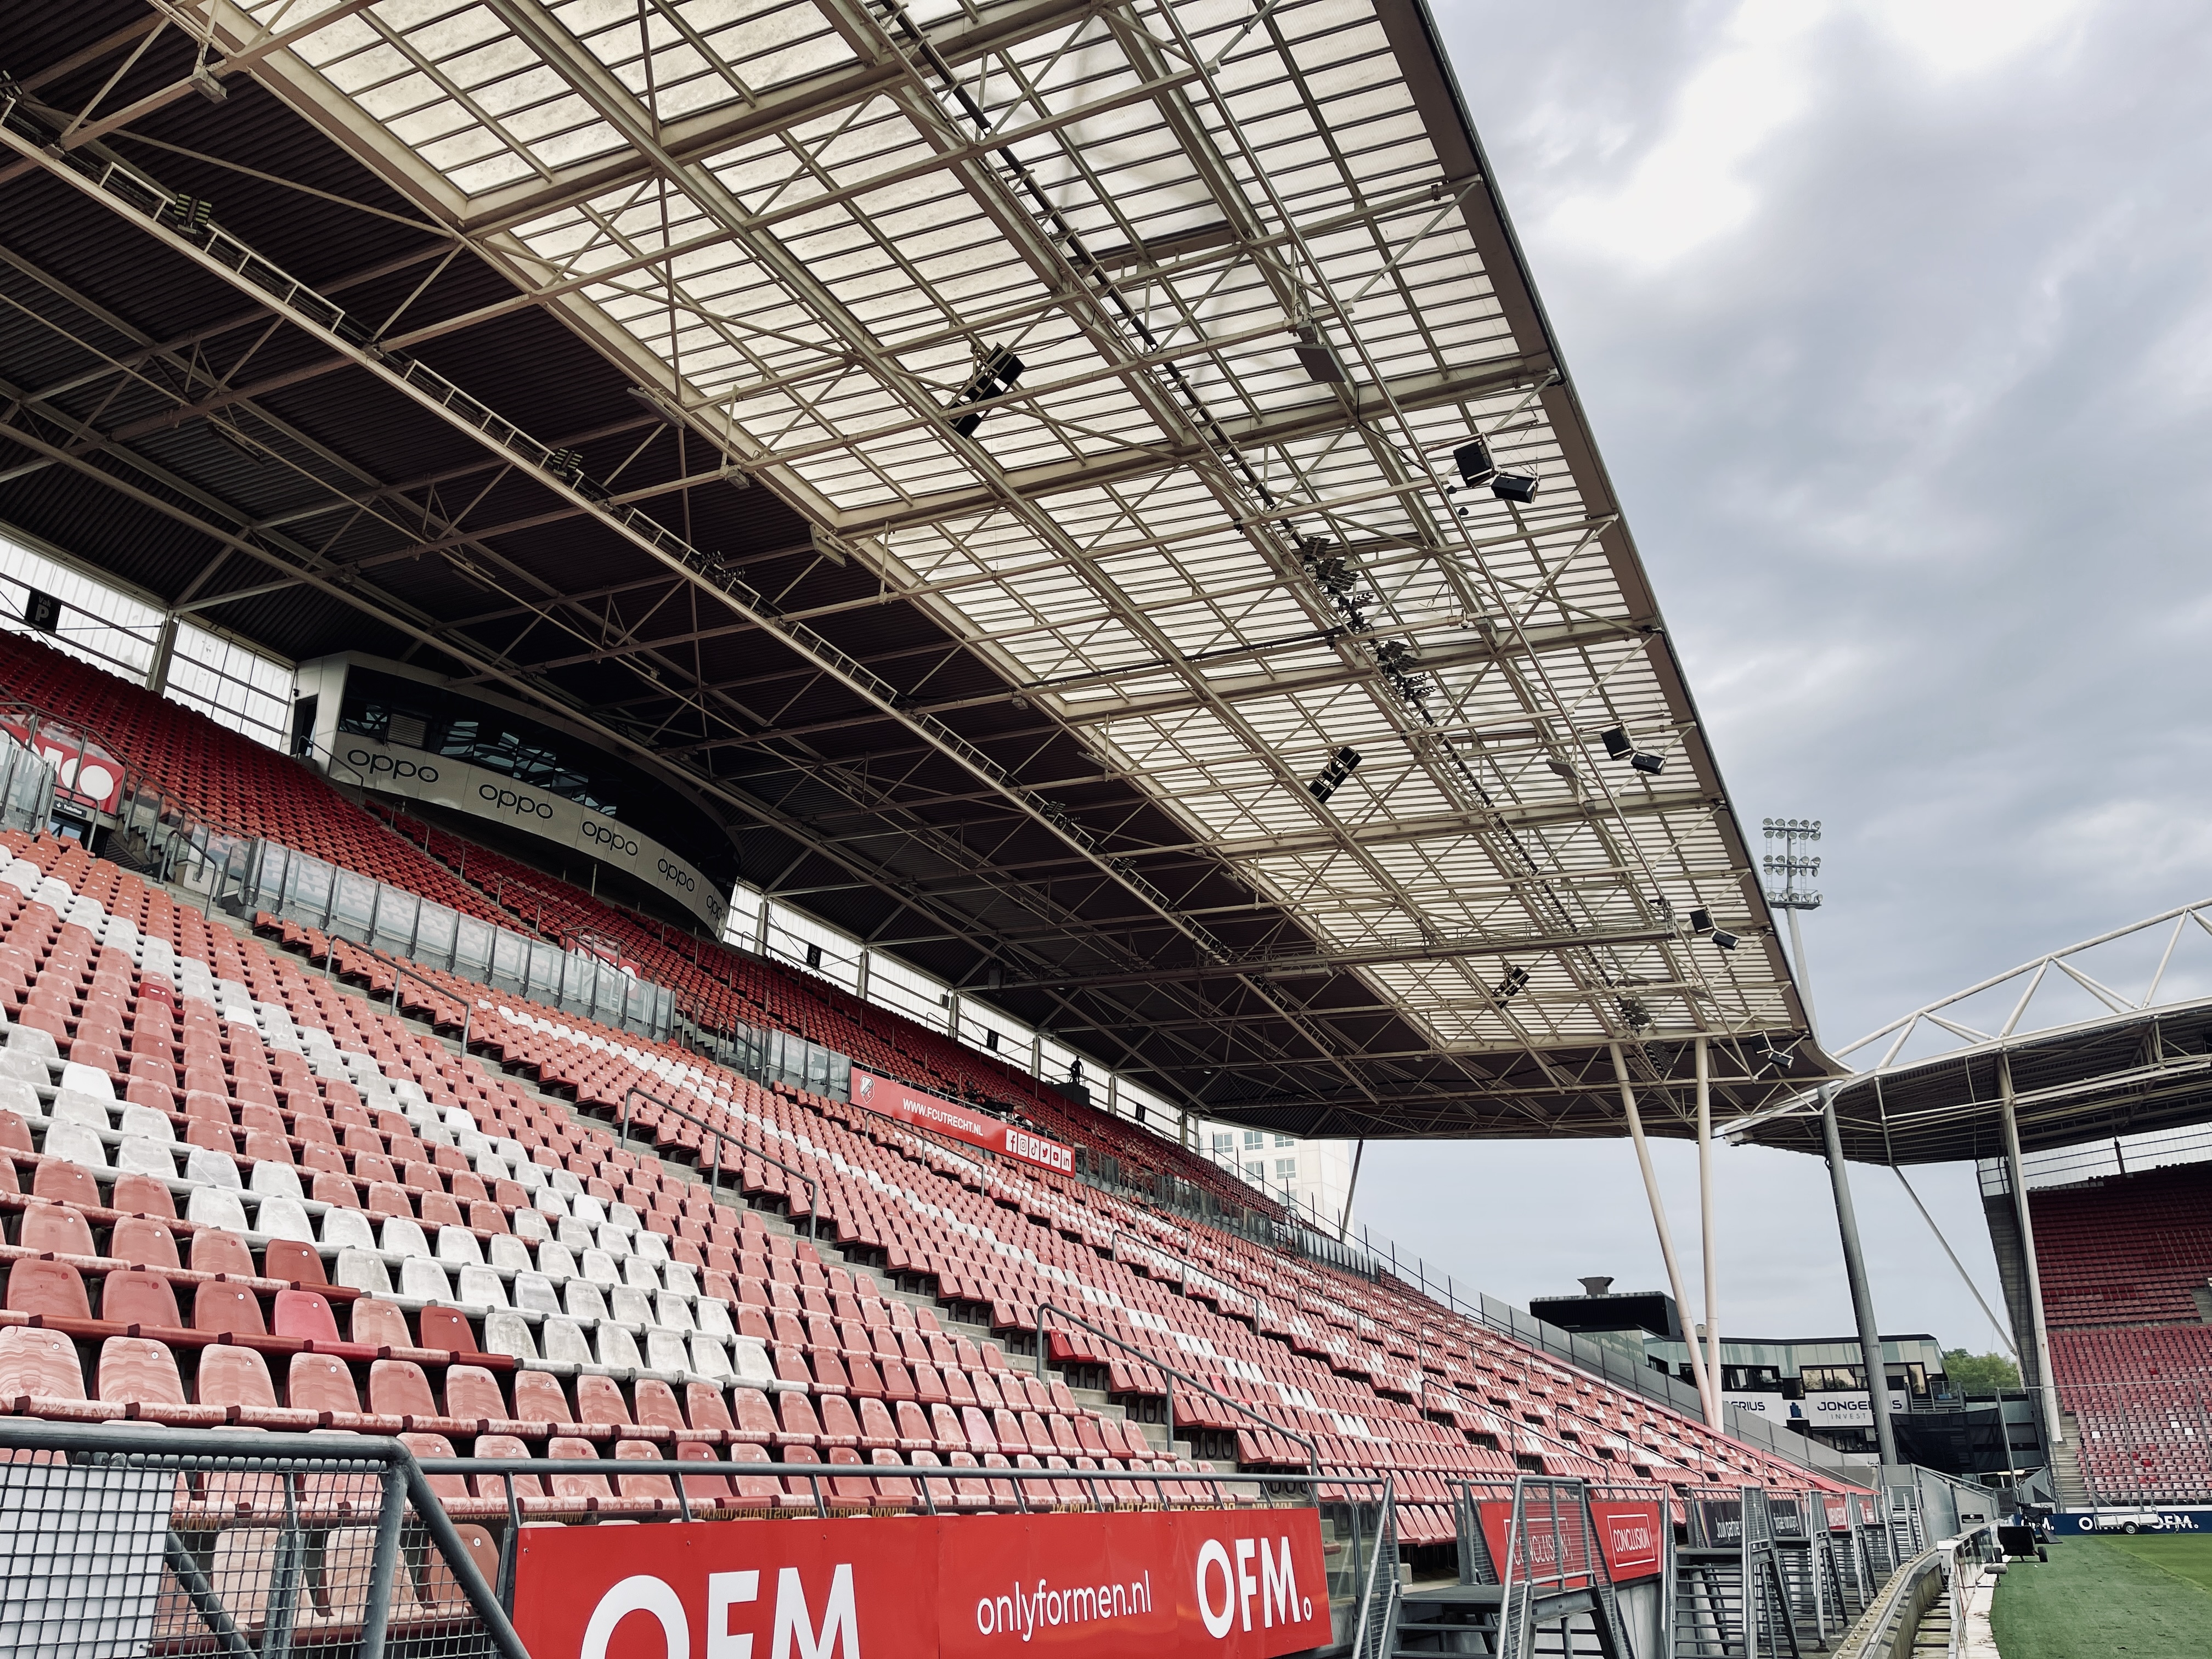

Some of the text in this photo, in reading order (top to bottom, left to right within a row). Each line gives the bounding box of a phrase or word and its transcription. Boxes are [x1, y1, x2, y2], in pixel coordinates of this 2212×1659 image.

[38, 596, 52, 607] Vak
[35, 604, 49, 622] P
[347, 749, 439, 783] oppo
[479, 784, 554, 819] oppo
[582, 821, 638, 856] oppo
[658, 858, 695, 892] oppo
[810, 952, 817, 964] S
[902, 1098, 984, 1137] WWW.FCUTRECHT.NL
[1817, 1400, 1903, 1411] JONGES
[1613, 1527, 1651, 1552] CONCLUSION
[977, 1569, 1152, 1642] onlyformen.nl
